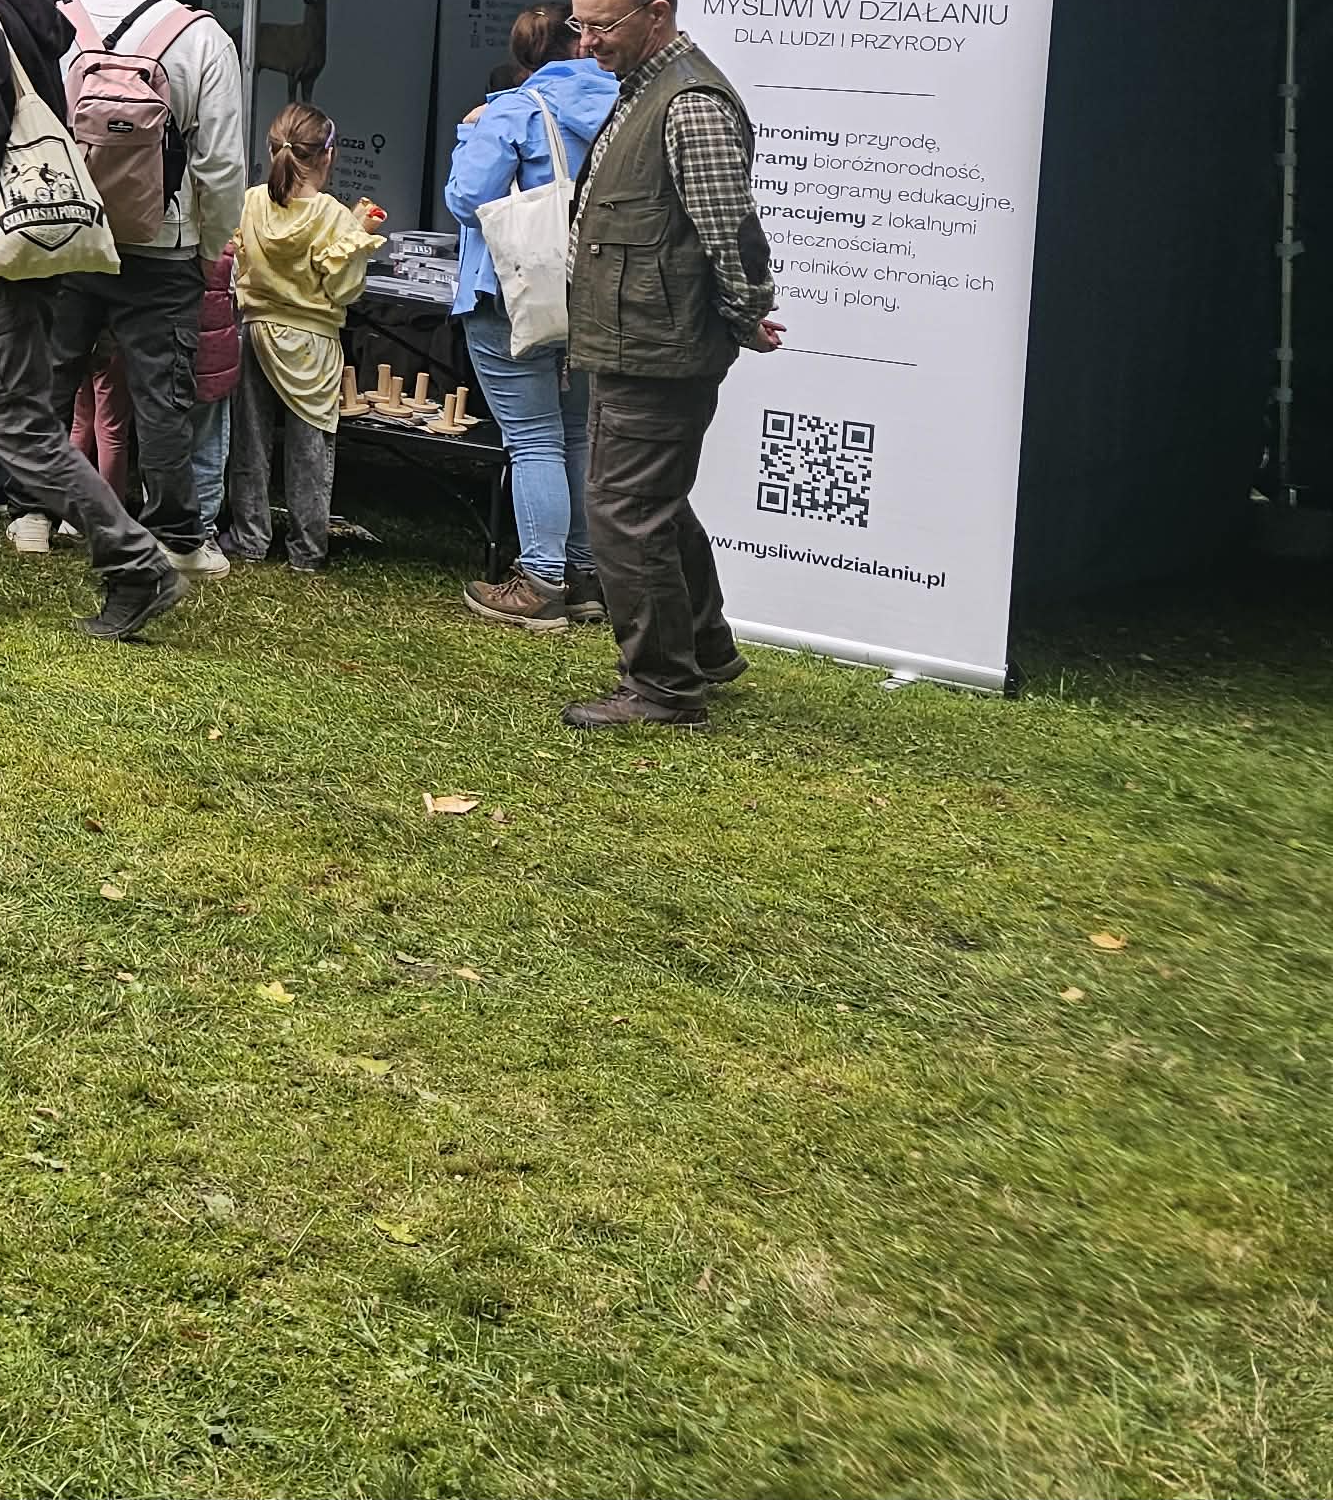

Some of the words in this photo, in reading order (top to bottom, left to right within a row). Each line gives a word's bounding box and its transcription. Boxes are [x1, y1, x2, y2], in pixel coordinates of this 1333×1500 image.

[822, 0, 851, 20] W
[859, 0, 1010, 26] DZIAŁANIU
[734, 28, 774, 45] DLA
[779, 30, 834, 47] LUDZI
[840, 32, 845, 48] I
[850, 32, 966, 53] PRZYRODY
[337, 137, 365, 150] oza
[845, 131, 941, 153] przyrodę,
[813, 153, 985, 183] bioróżnorodność,
[793, 181, 893, 204] programy
[897, 188, 1015, 212] edukacyjne,
[871, 214, 883, 227] z
[888, 211, 978, 237] lokalnymi
[790, 258, 869, 278] rolników
[873, 265, 960, 291] chroniąc
[965, 275, 995, 292] ich
[843, 289, 901, 313] plony.
